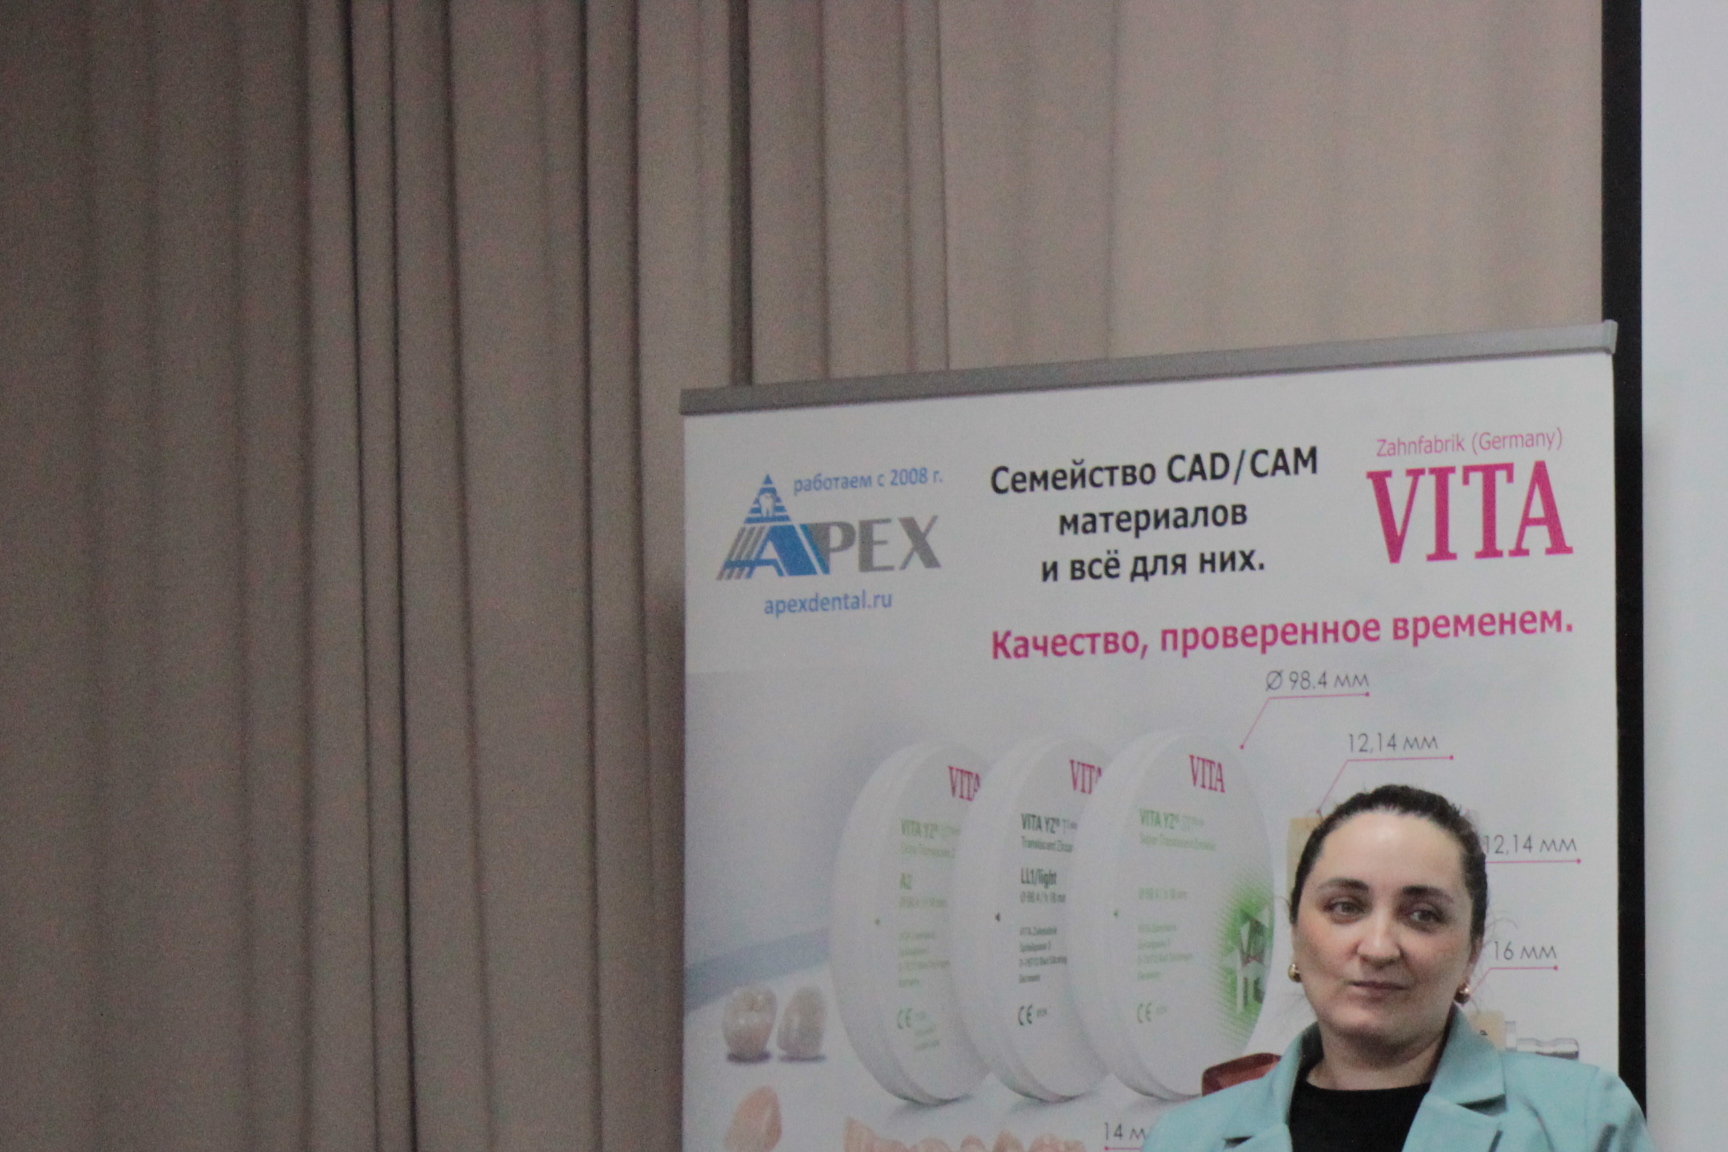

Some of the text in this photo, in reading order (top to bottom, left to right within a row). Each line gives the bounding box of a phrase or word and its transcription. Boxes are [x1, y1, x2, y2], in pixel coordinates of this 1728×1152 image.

[1376, 427, 1563, 457] Zahnfabrik (Germany)
[793, 467, 943, 496] работаем с 2008 г.
[990, 446, 1318, 495] Семейство CAD/CAM
[1059, 503, 1248, 538] материалов
[1366, 460, 1574, 564] VITA
[716, 514, 941, 581] APEX
[1041, 550, 1265, 582] и всё для них.
[764, 589, 893, 617] apexdental.ru
[991, 609, 1573, 660] Качество, проверенное временем.
[1289, 670, 1327, 690] 98.4
[1347, 733, 1398, 754] 12,14
[1189, 754, 1226, 793] VITA
[1482, 834, 1533, 856] 12,14
[1493, 941, 1514, 961] 16
[1104, 1122, 1122, 1140] 14
